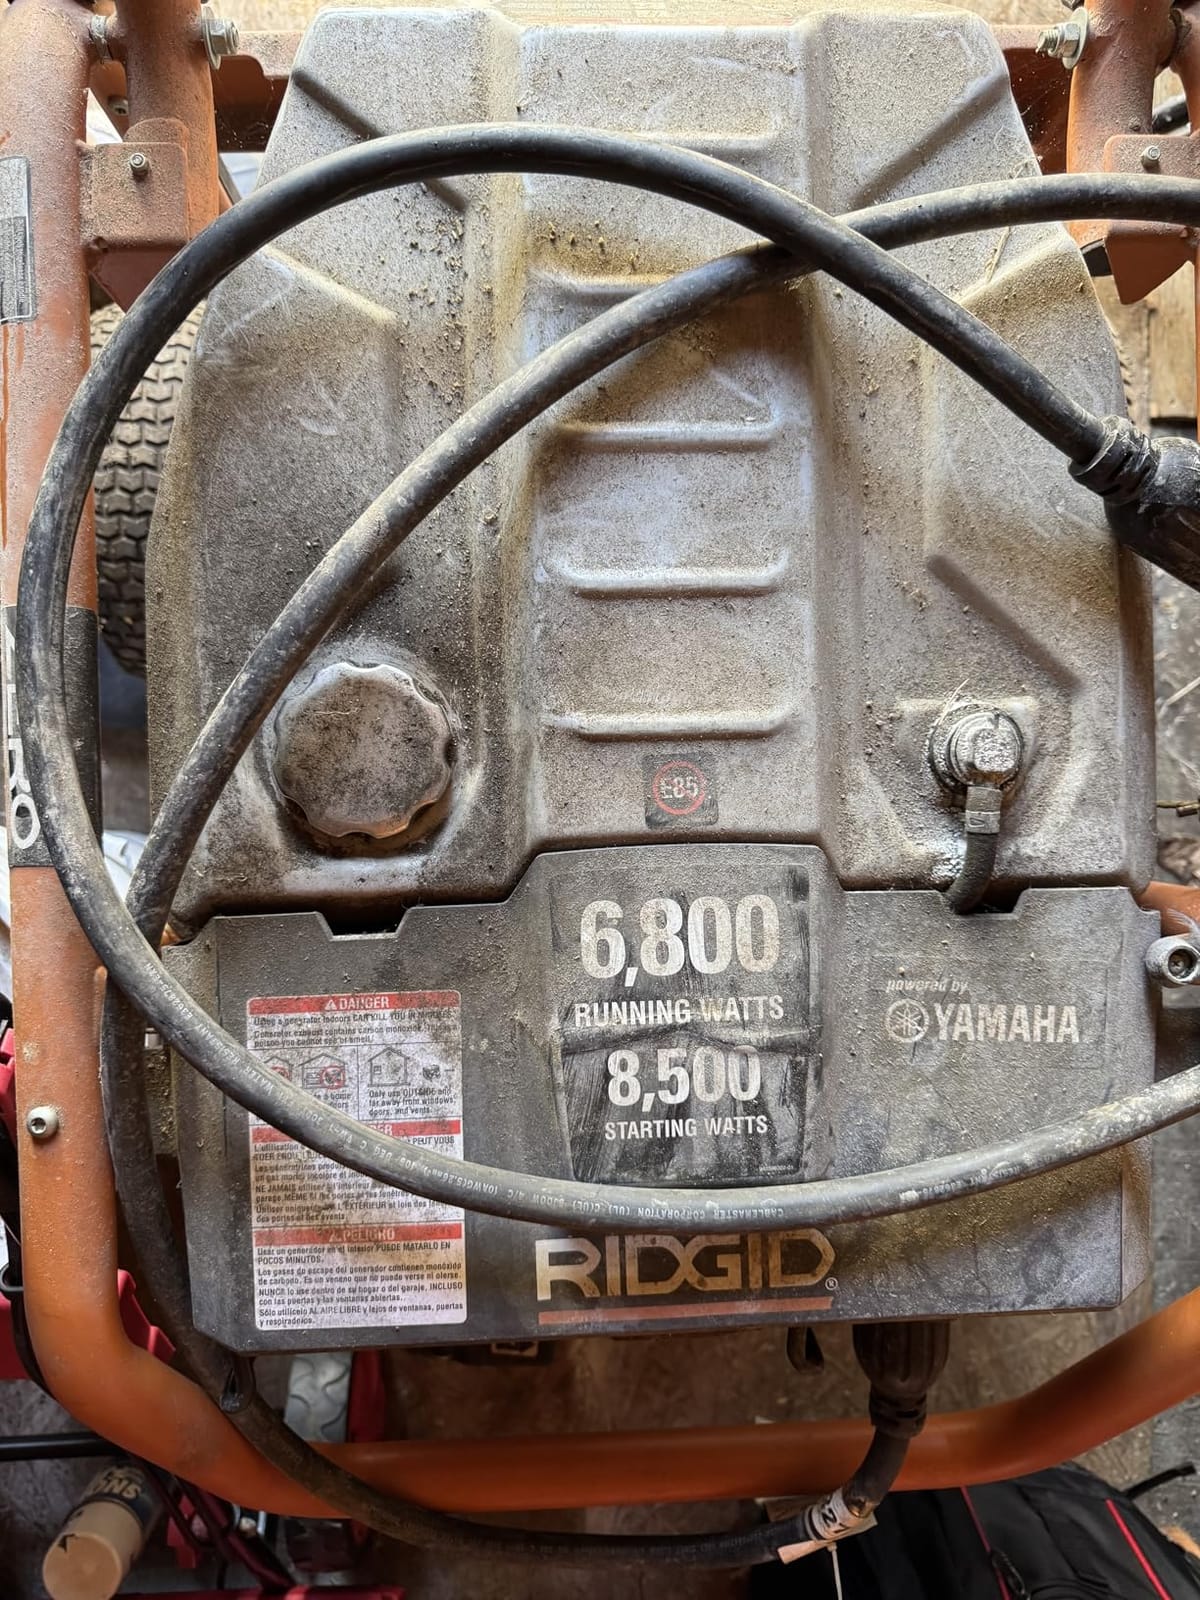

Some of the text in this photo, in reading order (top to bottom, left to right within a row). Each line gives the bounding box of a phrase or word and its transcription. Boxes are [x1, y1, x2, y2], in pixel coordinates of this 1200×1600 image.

[579, 894, 779, 987] 6,800
[886, 978, 968, 994] powered by
[340, 996, 389, 1011] DANGER
[574, 995, 784, 1027] RUNNING WATTS
[934, 1003, 1080, 1043] YAMAHA
[197, 1022, 240, 1064] RESISTANT
[244, 1065, 274, 1094] WATER
[607, 1045, 761, 1113] 8,500
[604, 1115, 768, 1140] STARTING WATTS
[358, 1139, 368, 1150] C
[413, 1135, 455, 1145] PEUT VOUS
[372, 1145, 393, 1161] DEG
[607, 1202, 630, 1217] (UL)
[637, 1207, 705, 1219] CORPORATION
[713, 1207, 783, 1219] CABLEMASTER
[375, 1242, 401, 1252] PUEDE
[403, 1241, 438, 1251] MATARLO
[440, 1241, 451, 1249] EN
[257, 1256, 284, 1265] POCOS
[535, 1227, 836, 1301] RIDGID
[258, 1268, 271, 1276] Los
[349, 1264, 387, 1274] generador
[404, 1273, 425, 1281] verse
[388, 1283, 400, 1292] del
[429, 1281, 463, 1291] INCLUSO
[259, 1308, 276, 1317] Sólo
[309, 1306, 318, 1315] AL
[339, 1305, 361, 1314] LIBRE
[368, 1304, 387, 1314] lejos
[388, 1304, 397, 1313] de
[398, 1303, 434, 1313] ventanas,
[435, 1302, 463, 1312] puertas
